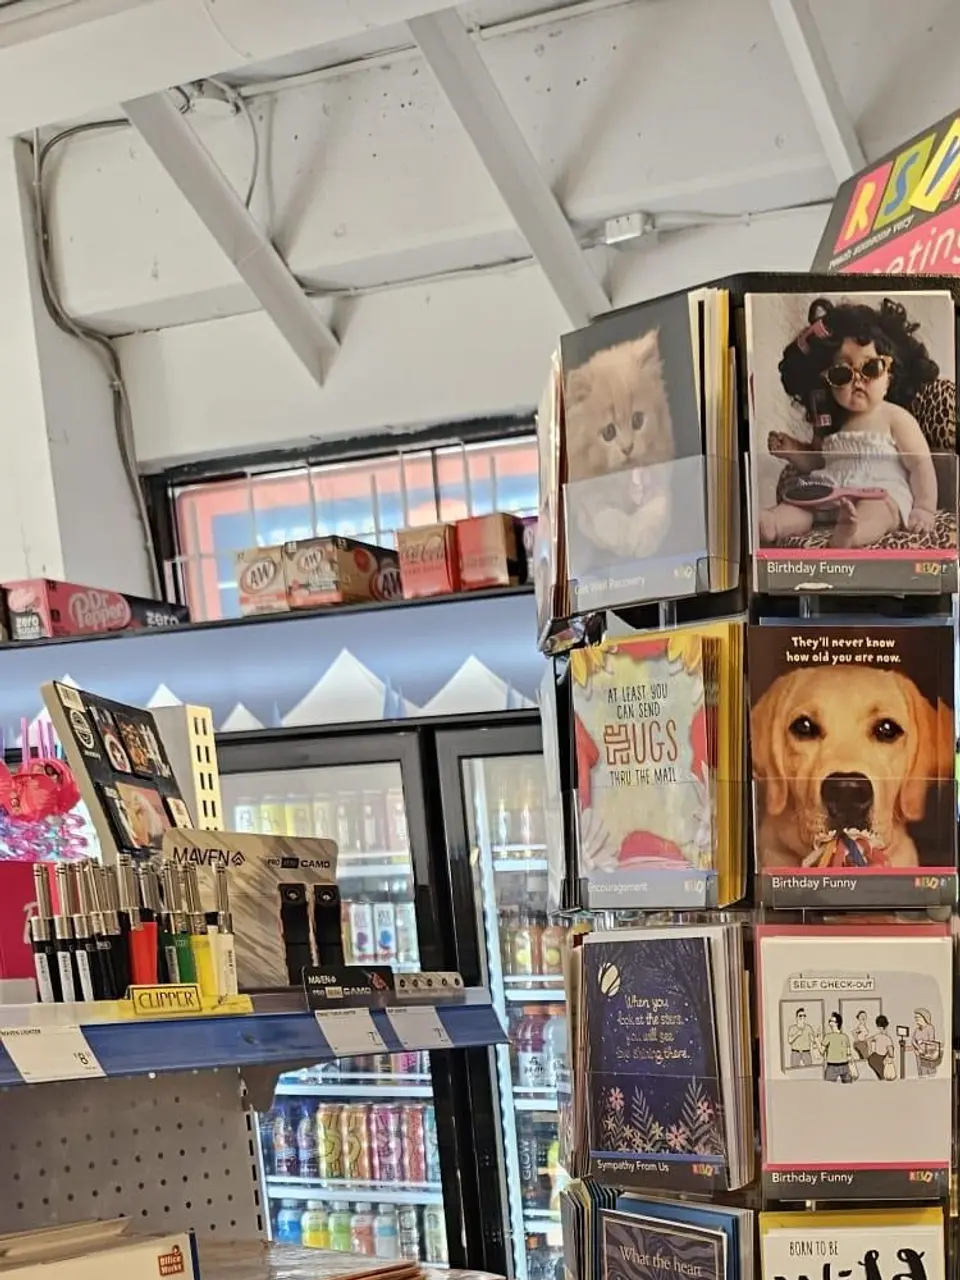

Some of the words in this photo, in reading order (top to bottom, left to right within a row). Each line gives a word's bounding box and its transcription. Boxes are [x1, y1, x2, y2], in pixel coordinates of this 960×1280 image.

[767, 561, 816, 576] Birthday
[819, 561, 855, 577] Funny
[75, 593, 124, 630] Pepper
[791, 636, 829, 649] They'll
[832, 639, 864, 647] never
[867, 636, 895, 647] know
[786, 651, 809, 662] how
[812, 651, 829, 662] old
[832, 655, 852, 665] you
[877, 655, 901, 663] now.
[607, 687, 618, 703] AT
[622, 686, 646, 702] LEAST
[651, 683, 669, 699] YOU
[616, 704, 634, 719] CAN
[638, 702, 661, 717] SEND
[604, 719, 678, 765] HUGS
[610, 769, 631, 787] THRU
[635, 770, 650, 784] THE
[654, 768, 677, 784] MAIL
[300, 859, 330, 869] CAMO
[772, 877, 819, 892] Birthday
[822, 877, 857, 892] Funny
[793, 981, 818, 990] SELF
[820, 980, 873, 990] CHECK-OUT
[138, 991, 194, 1009] CLIPPER
[624, 994, 650, 1009] When
[597, 1159, 635, 1174] Sympathy
[637, 1161, 658, 1173] From
[660, 1162, 670, 1174] Us
[772, 1172, 816, 1186] Birthday
[821, 1172, 853, 1186] Funny
[789, 1241, 813, 1256] BORN
[816, 1241, 826, 1255] TO
[829, 1241, 838, 1255] BE
[159, 1255, 182, 1266] Office
[620, 1244, 651, 1266] What
[653, 1250, 671, 1270] the
[673, 1256, 702, 1277] heart
